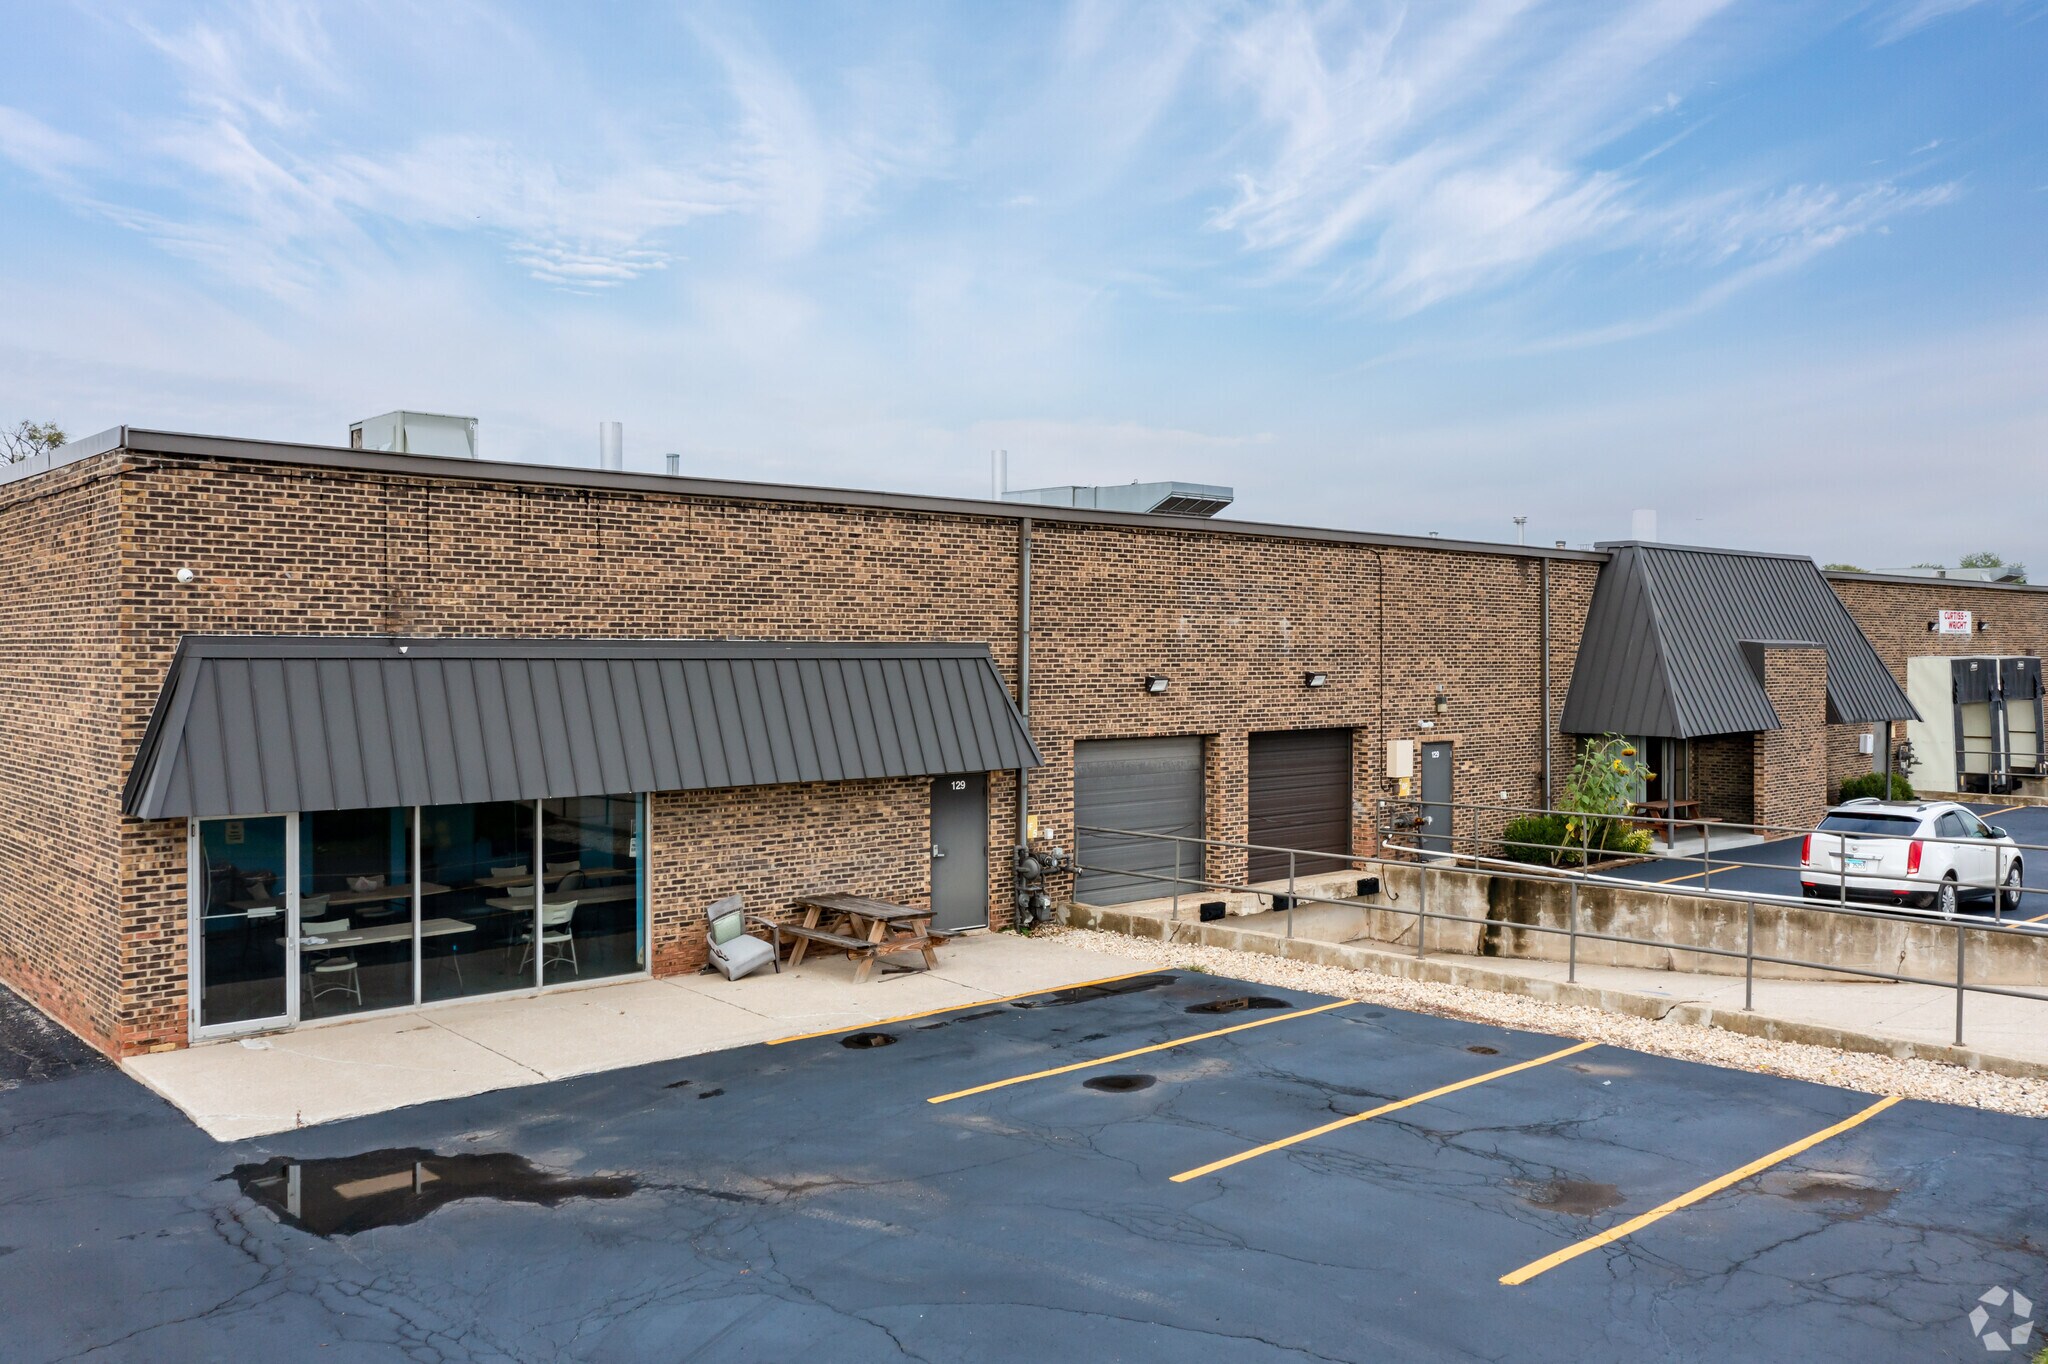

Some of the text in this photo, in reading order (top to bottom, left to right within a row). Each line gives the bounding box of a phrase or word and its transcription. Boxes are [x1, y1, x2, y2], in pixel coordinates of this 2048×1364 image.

[470, 421, 475, 429] 2
[1948, 621, 1967, 629] WRIGHT
[951, 780, 966, 790] 129
